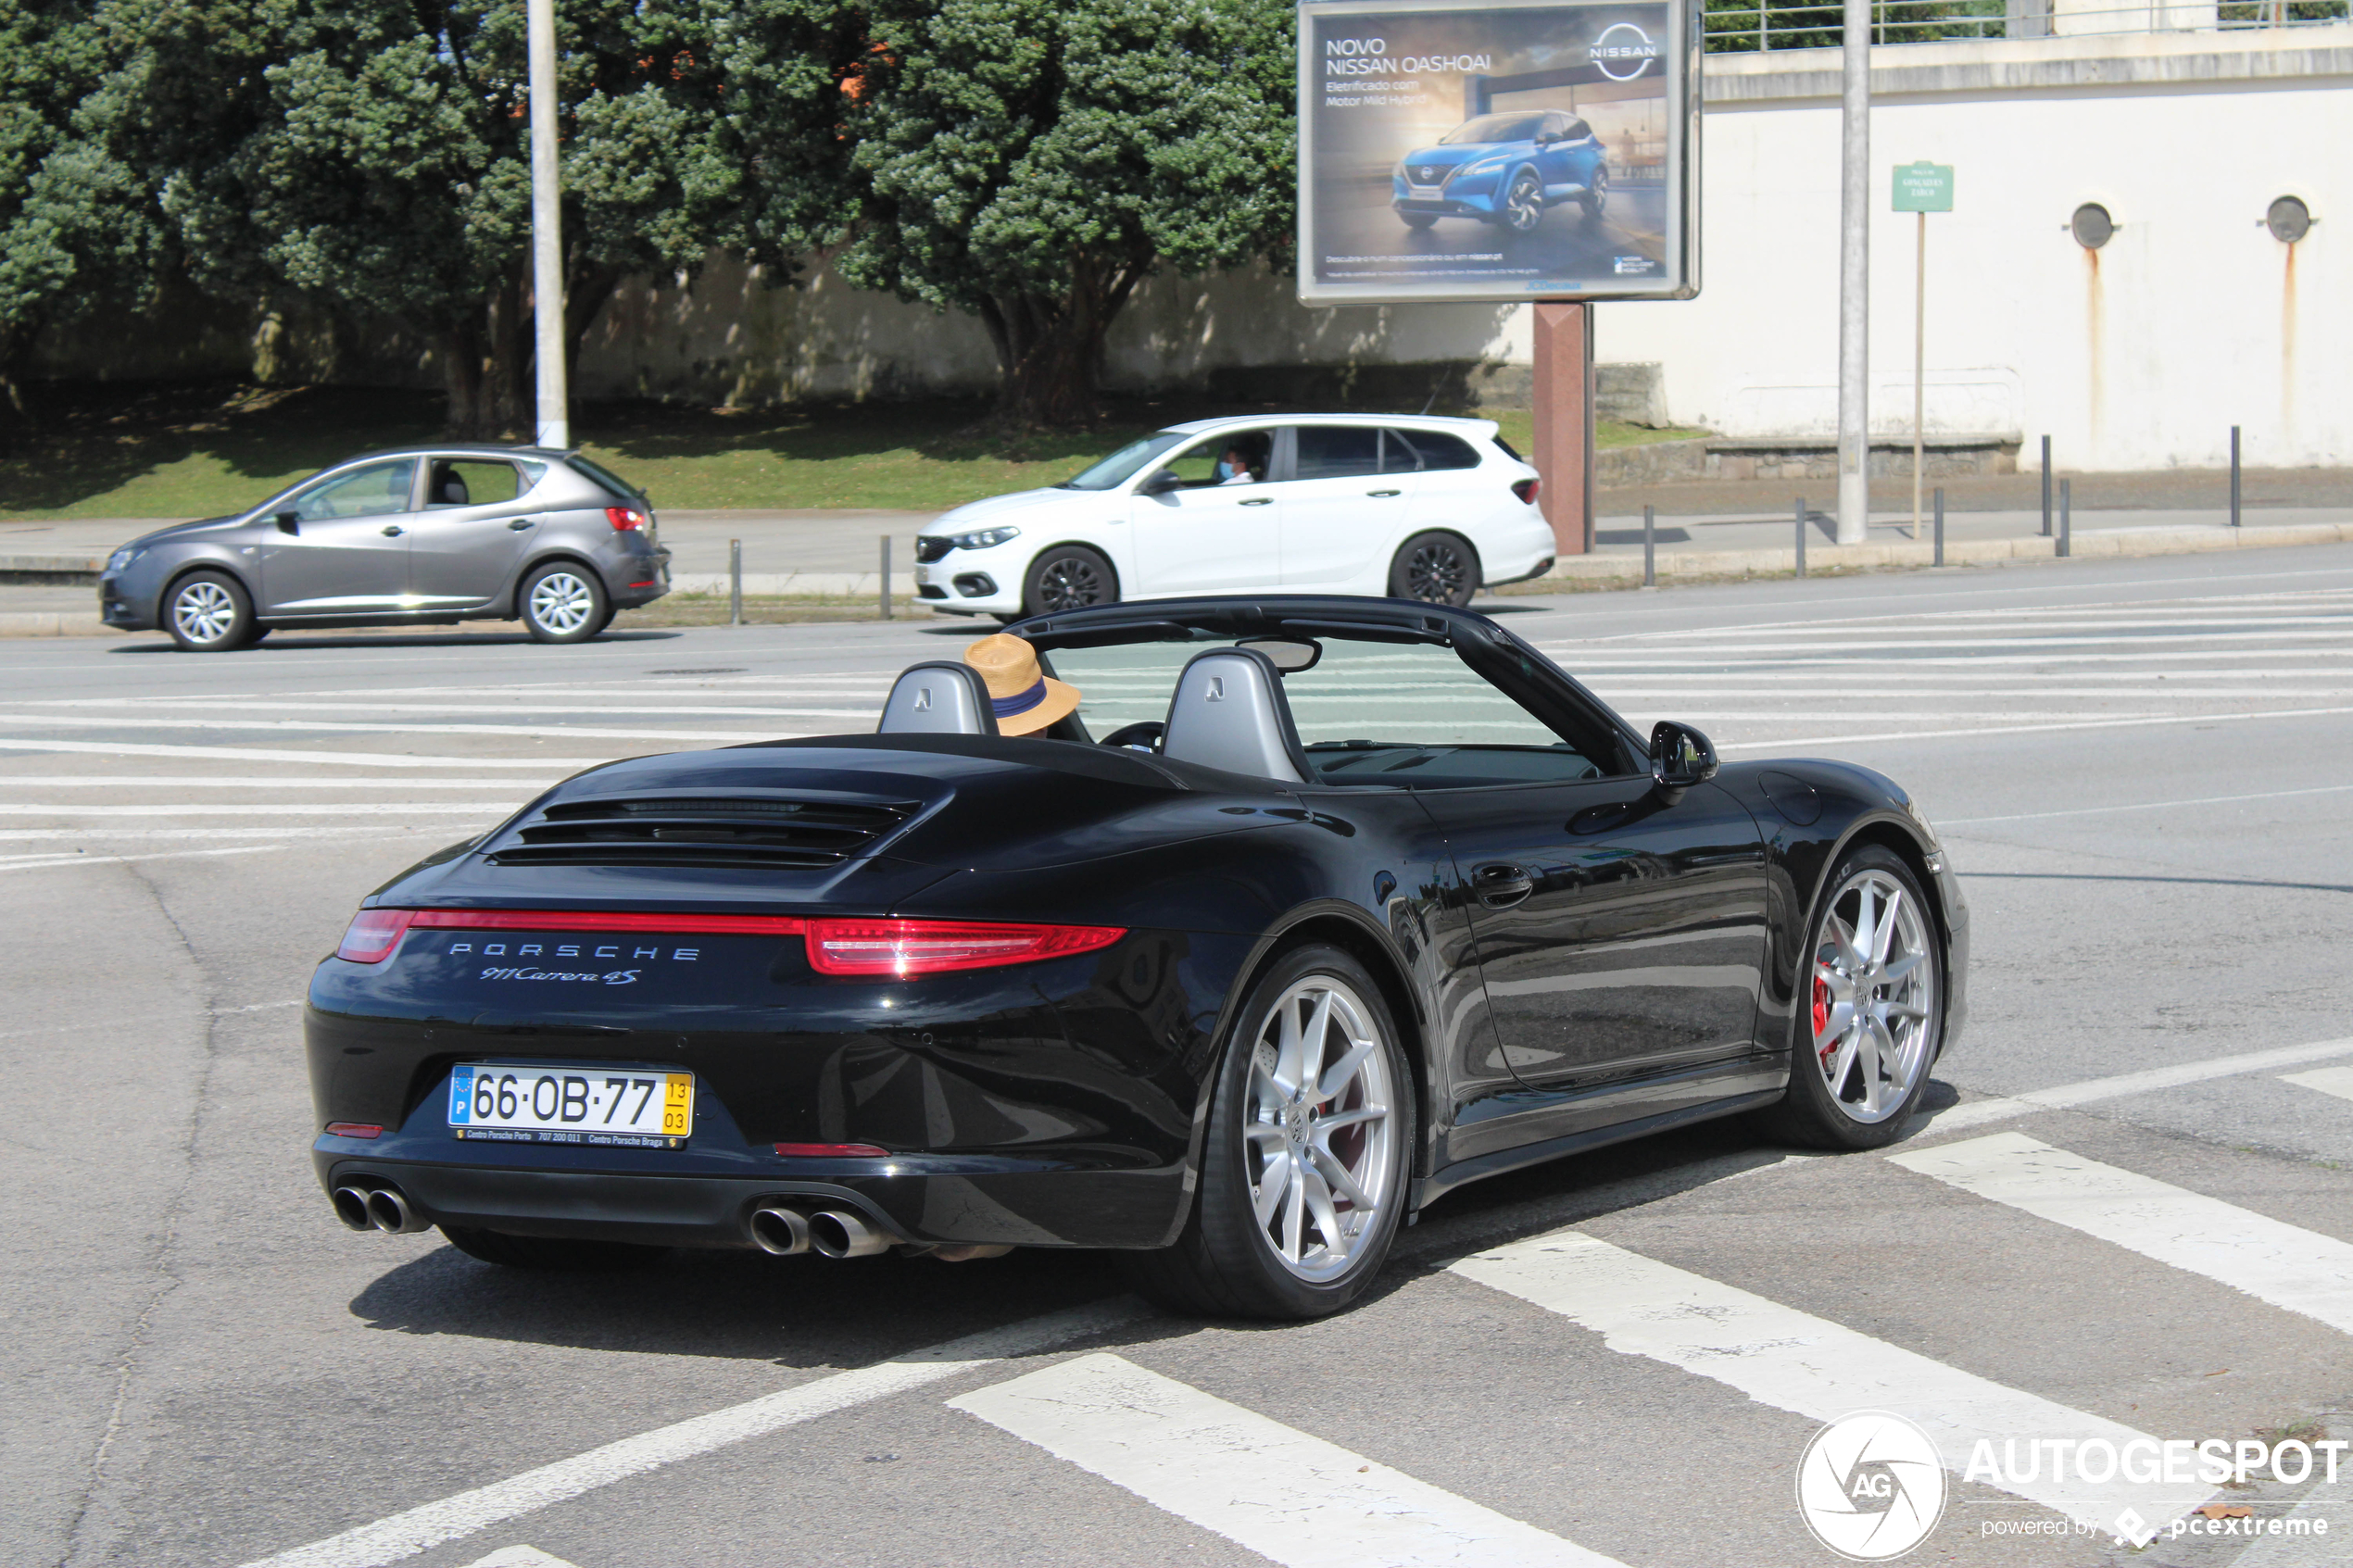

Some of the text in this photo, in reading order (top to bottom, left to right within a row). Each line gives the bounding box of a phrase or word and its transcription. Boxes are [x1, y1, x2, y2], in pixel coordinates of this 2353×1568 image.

[1326, 38, 1387, 56] NOVO
[1589, 46, 1656, 57] NISSAN
[1326, 54, 1491, 76] NISSAN QASHQAI
[1326, 80, 1420, 93] Eletrificado com
[1326, 94, 1428, 107] Motor Mild Hybrid
[1525, 279, 1582, 291] JCDecaux
[448, 943, 700, 961] PORSCHE
[601, 969, 642, 985] 4S
[670, 1082, 686, 1098] 13
[456, 1100, 466, 1114] P
[664, 1112, 684, 1129] 03
[467, 1129, 663, 1148] Centro Porsche Porto 707 200 011 Centro Porsche Braga
